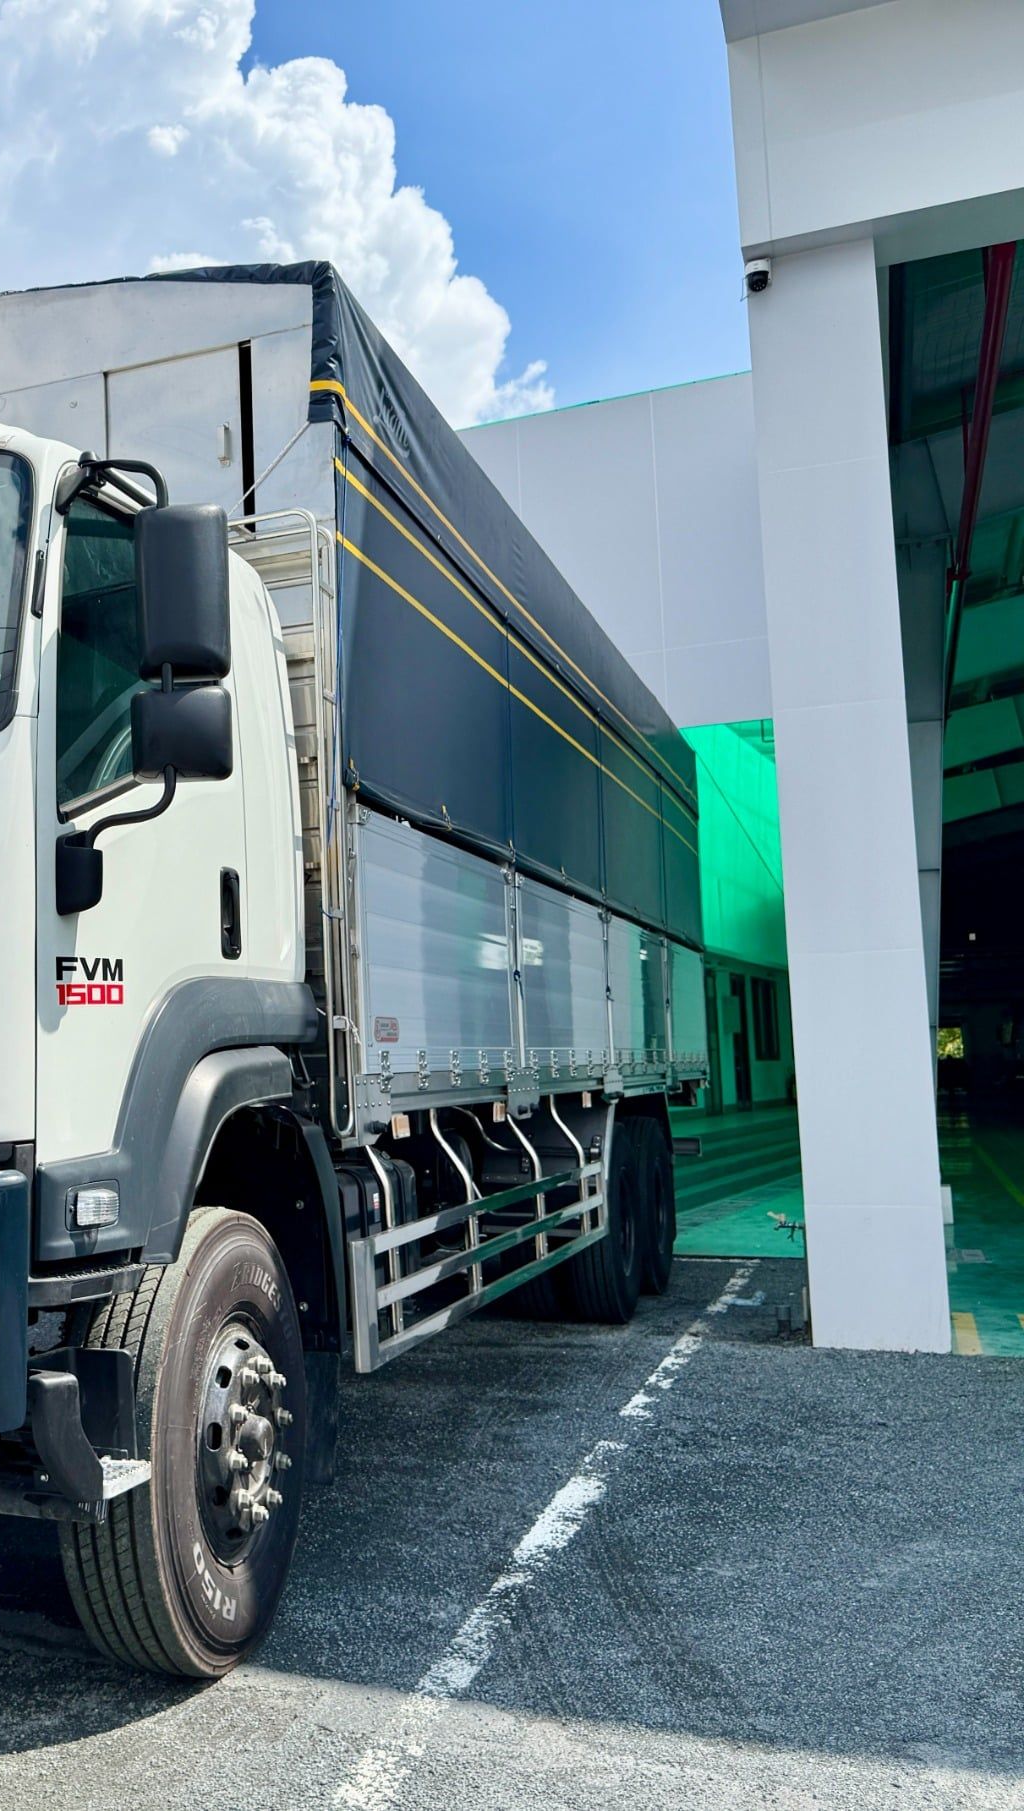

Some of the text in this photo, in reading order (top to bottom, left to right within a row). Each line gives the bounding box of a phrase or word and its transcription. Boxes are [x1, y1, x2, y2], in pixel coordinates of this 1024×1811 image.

[55, 956, 124, 982] FVM
[55, 983, 124, 1006] 1500
[192, 1541, 237, 1621] R150
